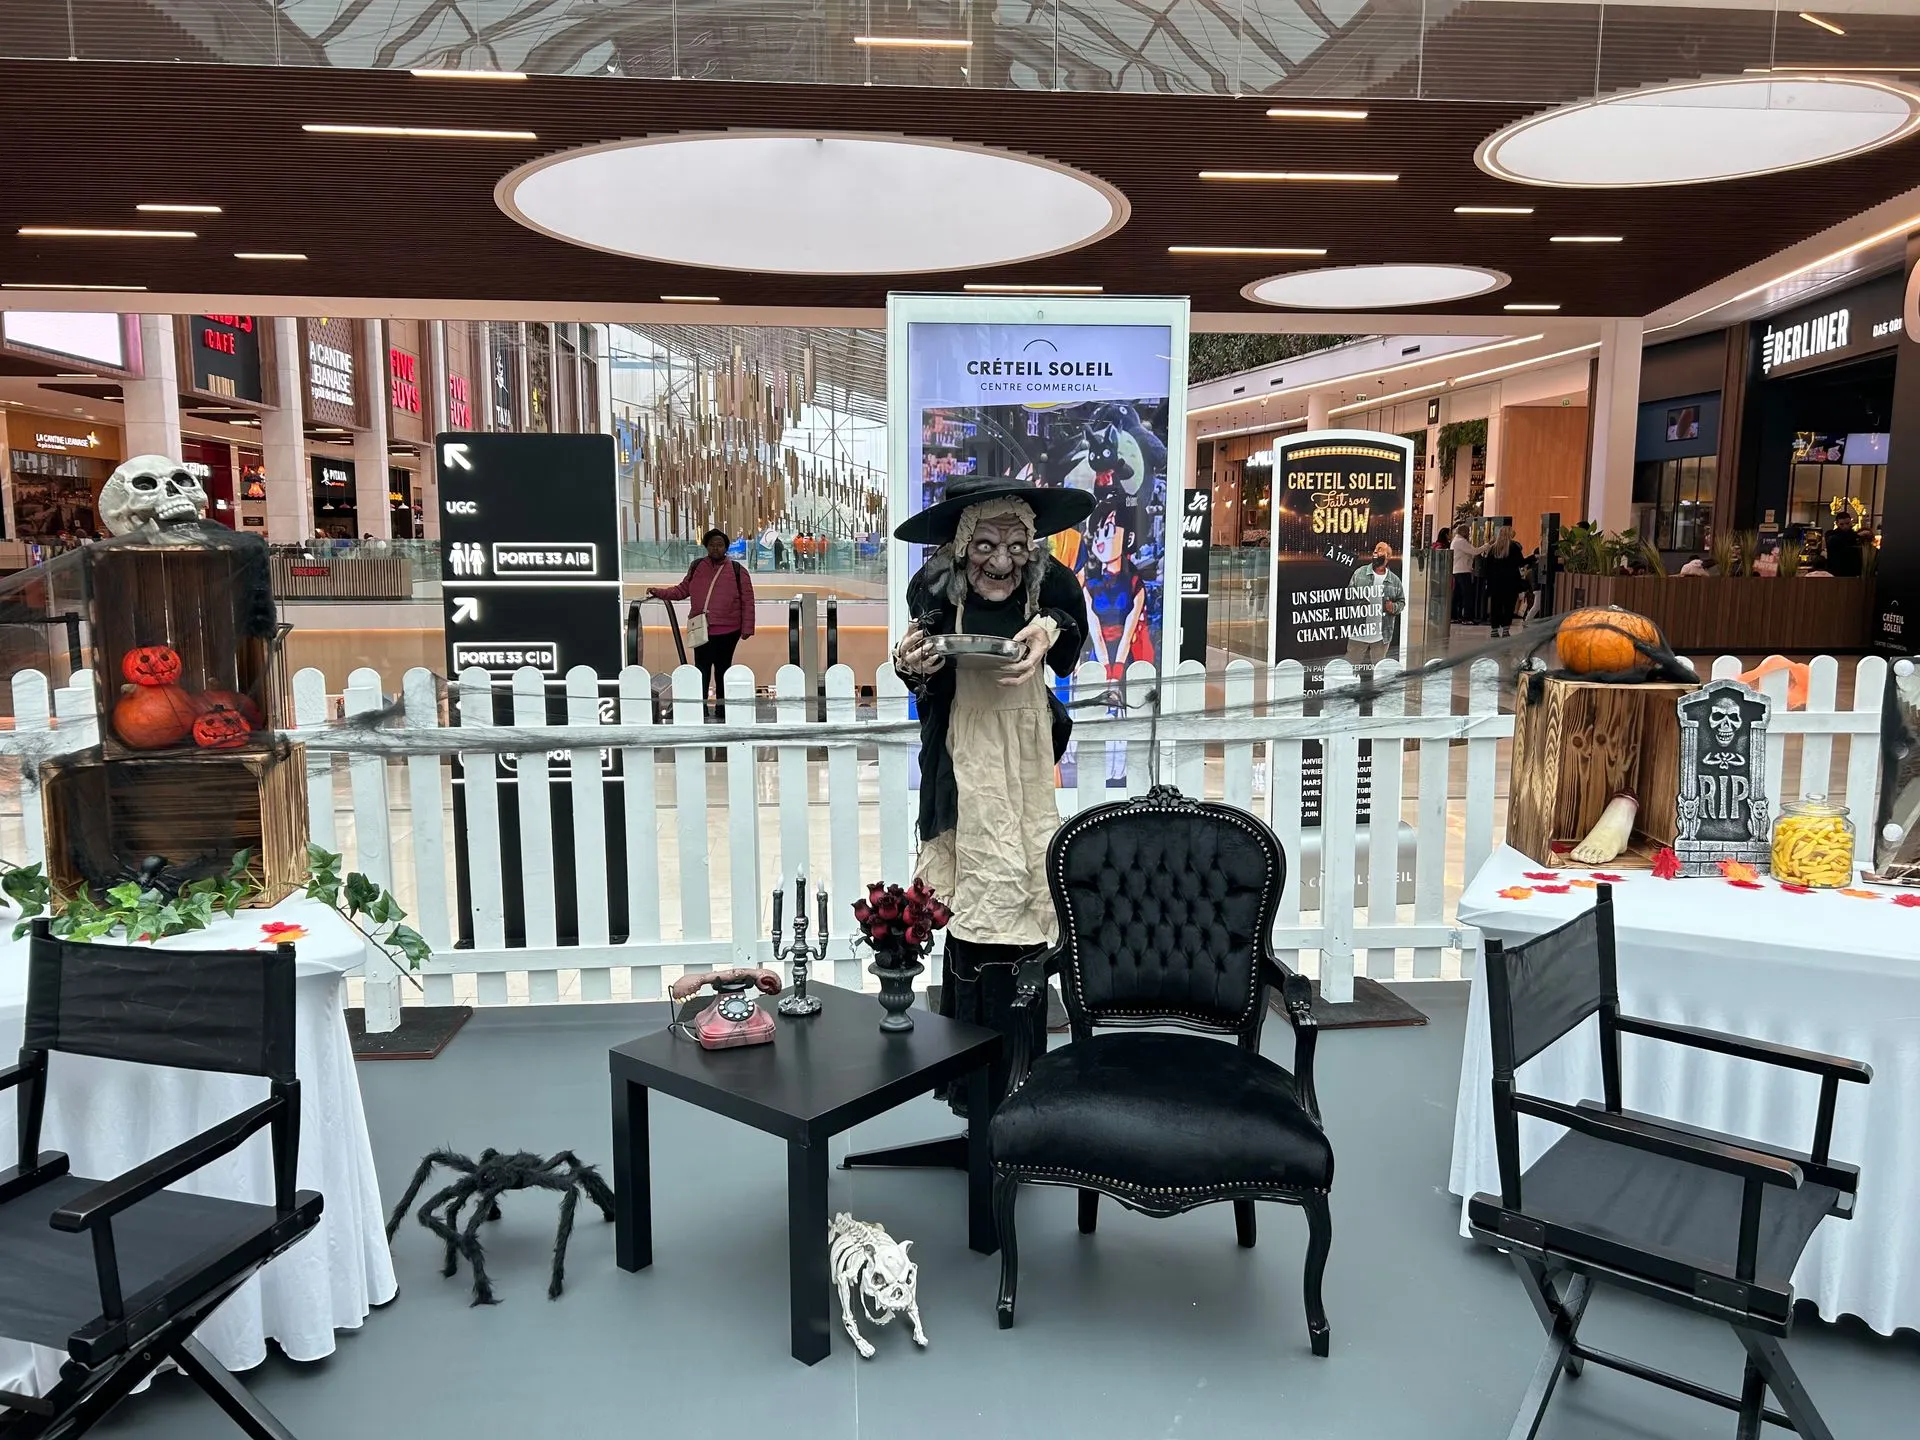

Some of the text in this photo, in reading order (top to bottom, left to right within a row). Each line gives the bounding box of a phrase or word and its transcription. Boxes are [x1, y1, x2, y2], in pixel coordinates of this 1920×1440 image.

[1873, 318, 1902, 338] DAS ORI
[1773, 309, 1849, 366] BERLINER
[317, 344, 352, 373] CANTINE
[390, 347, 416, 383] FIVE
[966, 358, 1113, 377] CRÉTEIL SOLEIL
[391, 379, 420, 413] GUYS
[450, 374, 469, 402] FIVE
[980, 382, 1099, 393] CENTRE COMMERCIAL
[450, 401, 472, 429] GUYS
[36, 433, 44, 442] LA
[44, 435, 65, 445] CANTINE
[1288, 472, 1397, 490] CRETEIL SOLEIL
[446, 501, 477, 514] UGC
[1311, 490, 1370, 509] Fait son
[1182, 515, 1203, 533] &M
[1312, 507, 1370, 534] SHOW
[1182, 538, 1203, 548] nac
[498, 552, 544, 565] PORTE
[545, 552, 562, 565] 33
[1336, 551, 1354, 567] 19H
[1292, 584, 1385, 606] UN SHOW UNIQUE
[1340, 622, 1377, 639] MAGIE
[459, 651, 504, 664] PORTE
[506, 651, 523, 664] 33
[1313, 665, 1326, 673] PAR
[1303, 689, 1325, 699] SOYE
[1698, 774, 1750, 820] RIP
